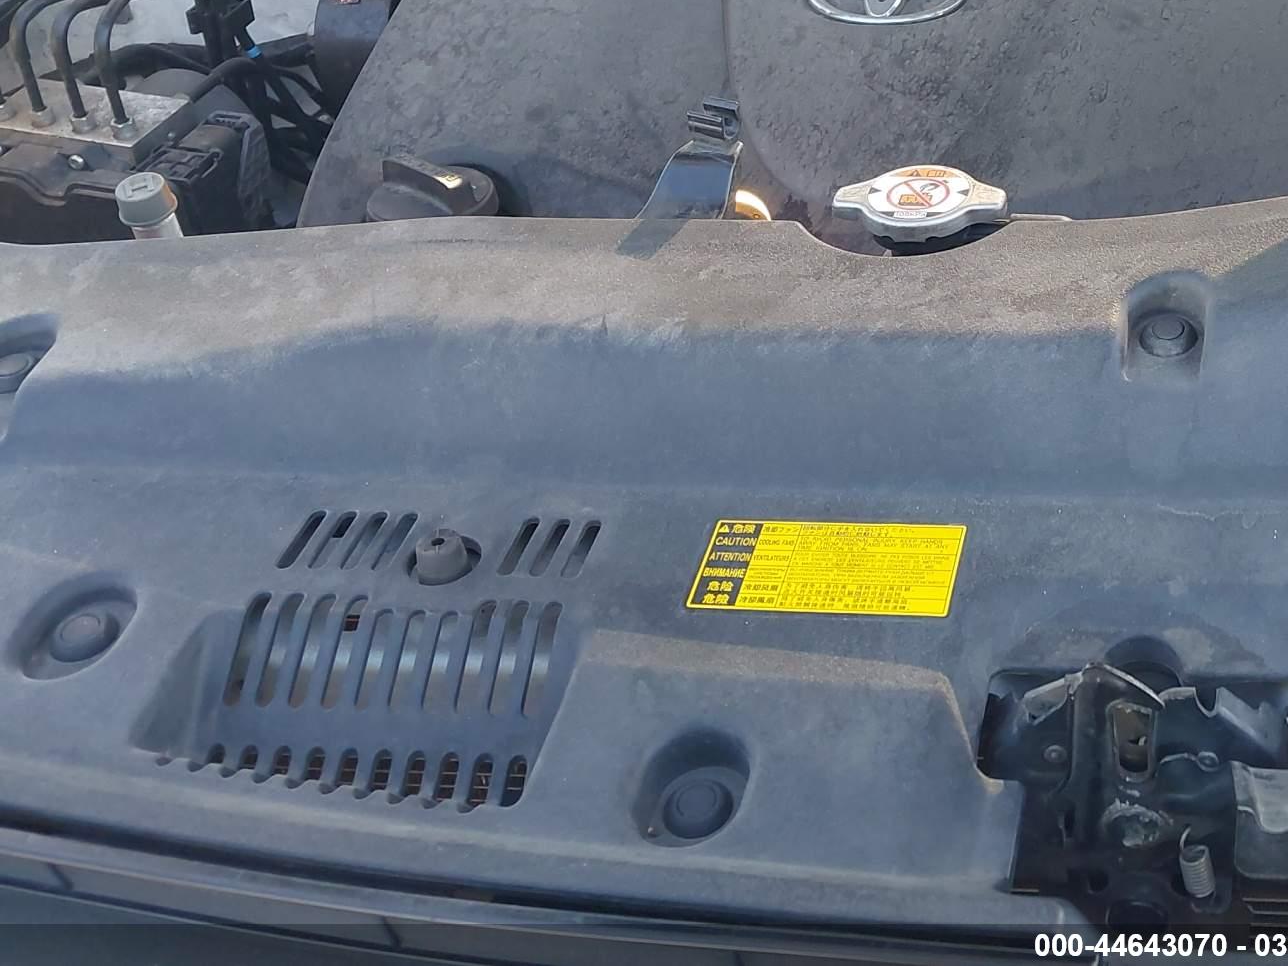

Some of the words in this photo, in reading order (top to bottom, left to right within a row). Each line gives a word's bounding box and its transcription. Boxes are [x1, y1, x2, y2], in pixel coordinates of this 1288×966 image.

[715, 536, 757, 547] CAUTION
[709, 552, 752, 562] ATTENTION
[702, 567, 746, 579] ВНИМАНИЕ
